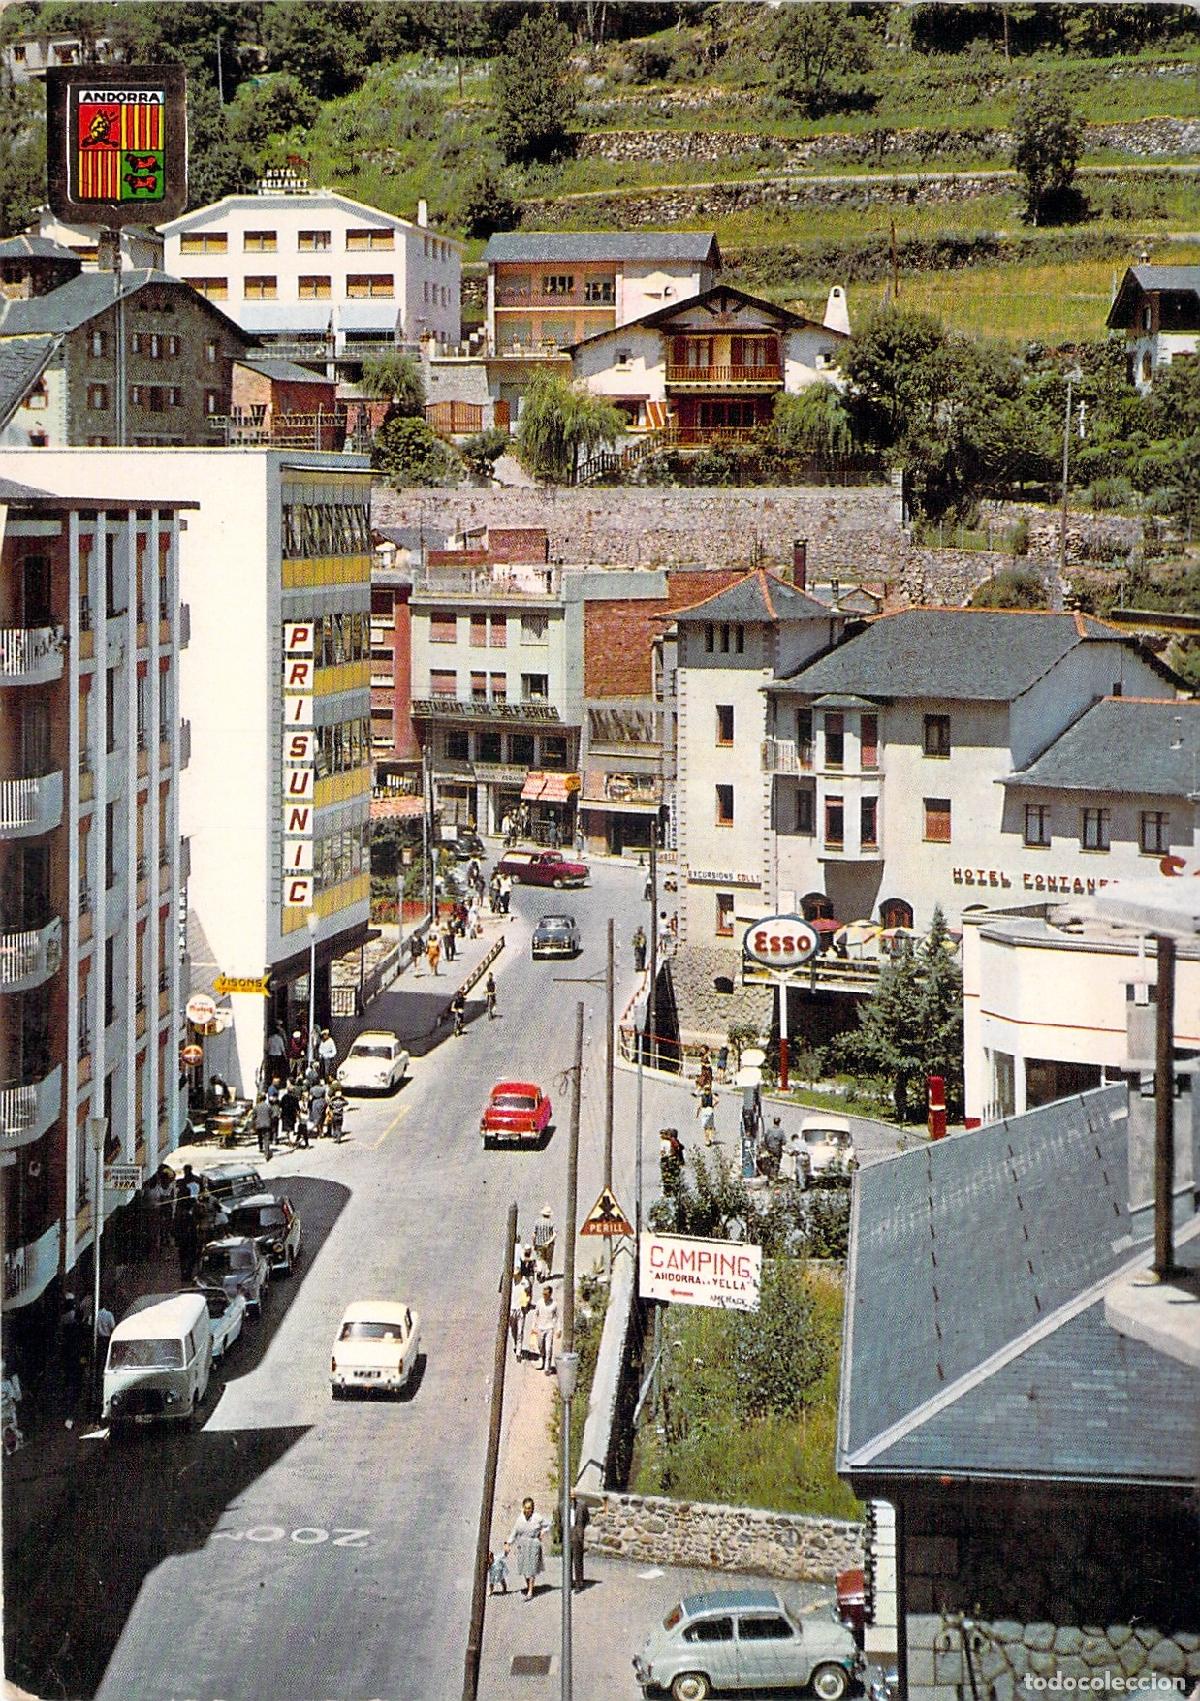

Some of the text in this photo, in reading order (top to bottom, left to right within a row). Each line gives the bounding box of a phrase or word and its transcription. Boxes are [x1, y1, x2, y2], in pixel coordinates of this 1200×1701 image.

[83, 92, 160, 102] ANDORRA
[266, 169, 297, 178] HOTEL
[498, 704, 521, 718] SELF
[289, 627, 309, 902] PRISUNIC
[687, 870, 734, 880] EXCURSIONS
[953, 868, 1009, 882] HOTEL
[220, 978, 262, 988] VISONS
[589, 1223, 624, 1232] PERILL
[650, 1245, 752, 1278] CAMPING
